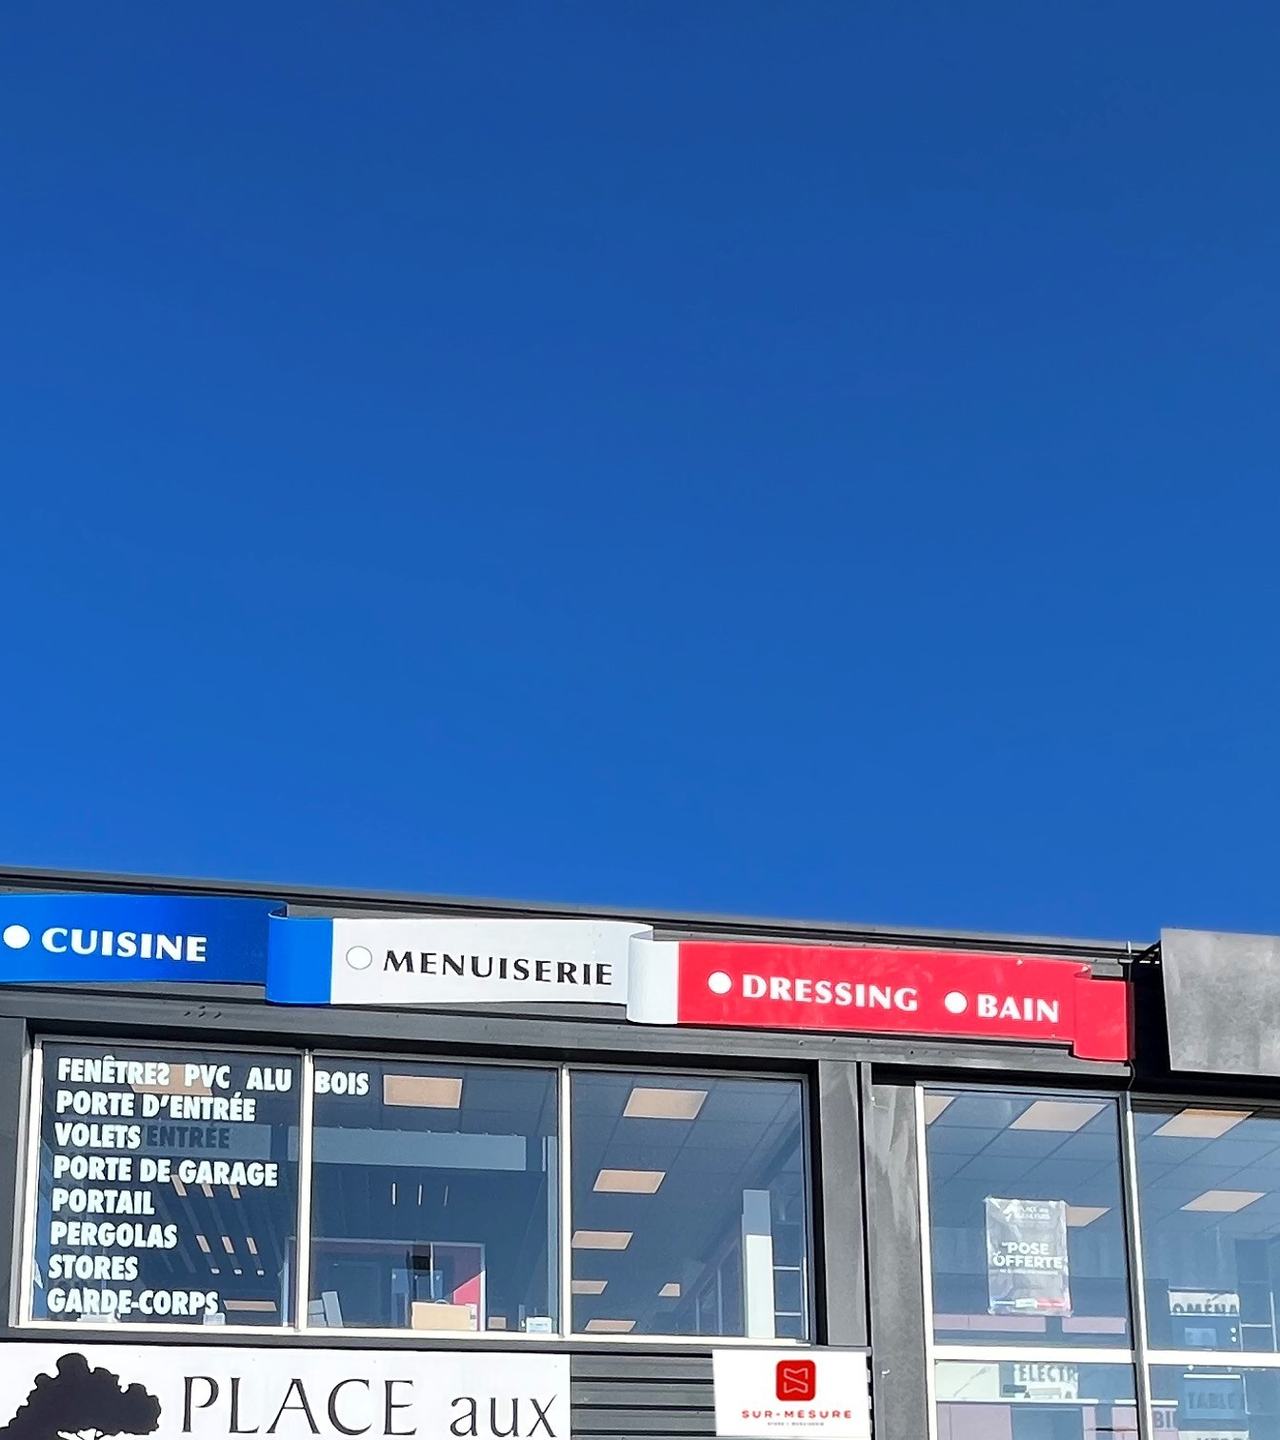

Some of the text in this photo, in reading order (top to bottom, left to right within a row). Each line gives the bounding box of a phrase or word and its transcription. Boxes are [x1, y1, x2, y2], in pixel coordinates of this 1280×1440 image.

[41, 926, 208, 964] CUISINE
[383, 948, 613, 987] MENUISERIE
[741, 973, 1060, 1024] DRESSING BAIN
[184, 1063, 231, 1090] PVC
[246, 1066, 292, 1092] ALU
[314, 1070, 370, 1096] BOIS
[55, 1089, 257, 1122] PORTE D'ENTRÉE
[53, 1122, 142, 1150] VOLETS
[52, 1154, 279, 1188] PORTE DE GARAGE
[51, 1187, 155, 1216] PORTAIL
[49, 1221, 178, 1250] PERGOLAS
[1006, 1241, 1050, 1256] POSE
[47, 1253, 139, 1282] STORES
[992, 1254, 1063, 1269] OFFERTE
[46, 1287, 219, 1316] GARDE-CORPS
[181, 1374, 558, 1439] PLACE aux
[741, 1409, 852, 1419] SUR-MESURE
